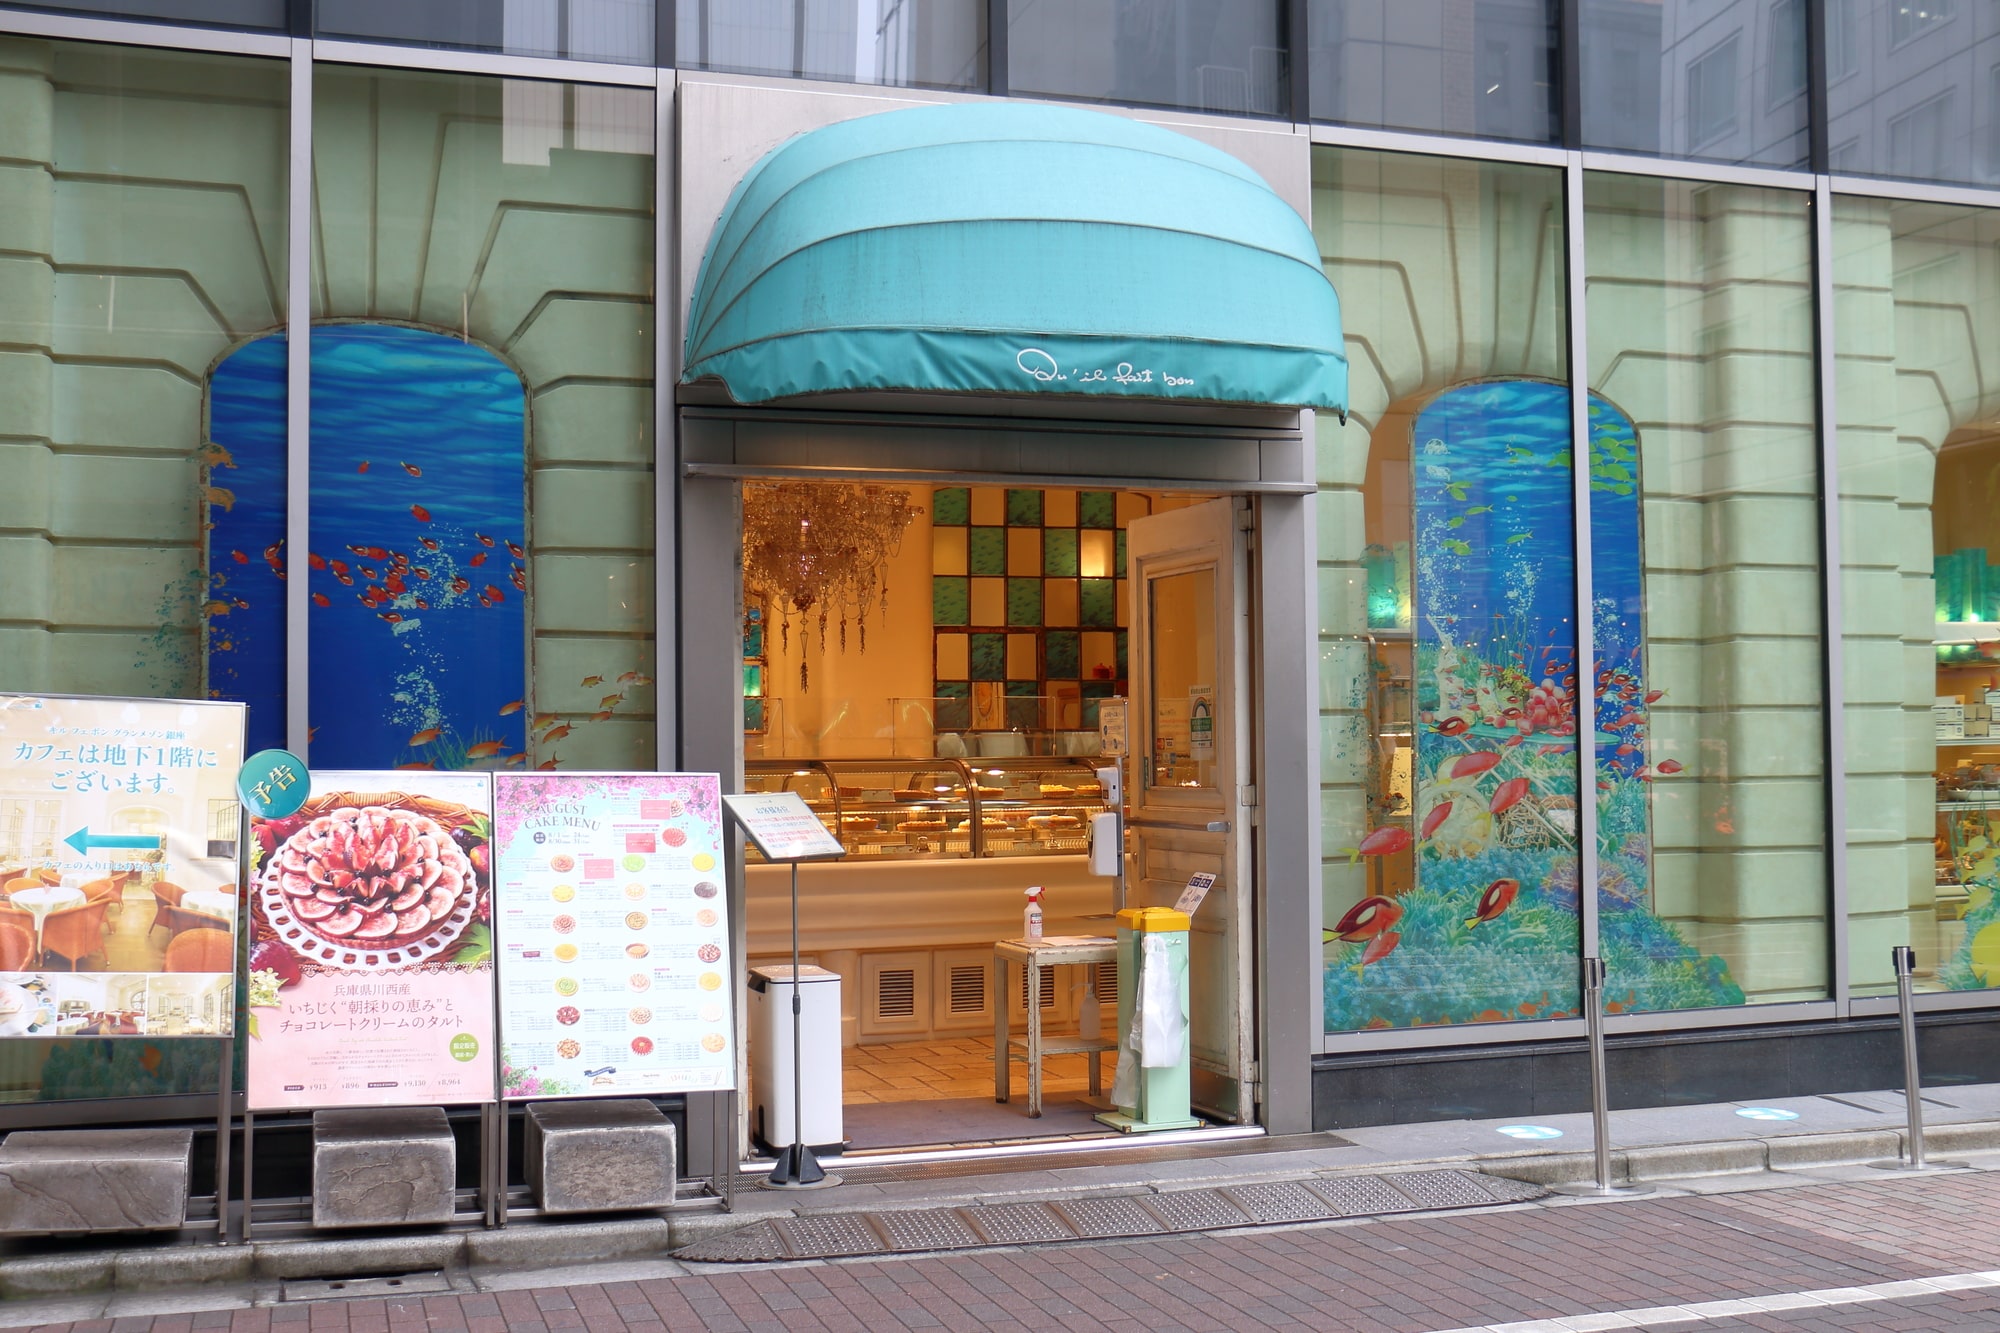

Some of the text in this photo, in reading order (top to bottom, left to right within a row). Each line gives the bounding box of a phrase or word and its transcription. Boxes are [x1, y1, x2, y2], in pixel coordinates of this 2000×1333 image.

[1112, 362, 1153, 385] fait
[1162, 371, 1195, 386] bon
[14, 742, 219, 769] カフェは地下1階に
[51, 770, 175, 795] ございます。
[248, 764, 297, 805] 予告
[538, 803, 588, 816] AUGUST
[524, 816, 601, 832] CAKE MENU
[333, 983, 412, 997] 兵庫県川西産
[280, 1015, 463, 1034] チョコレートクリームのタルト
